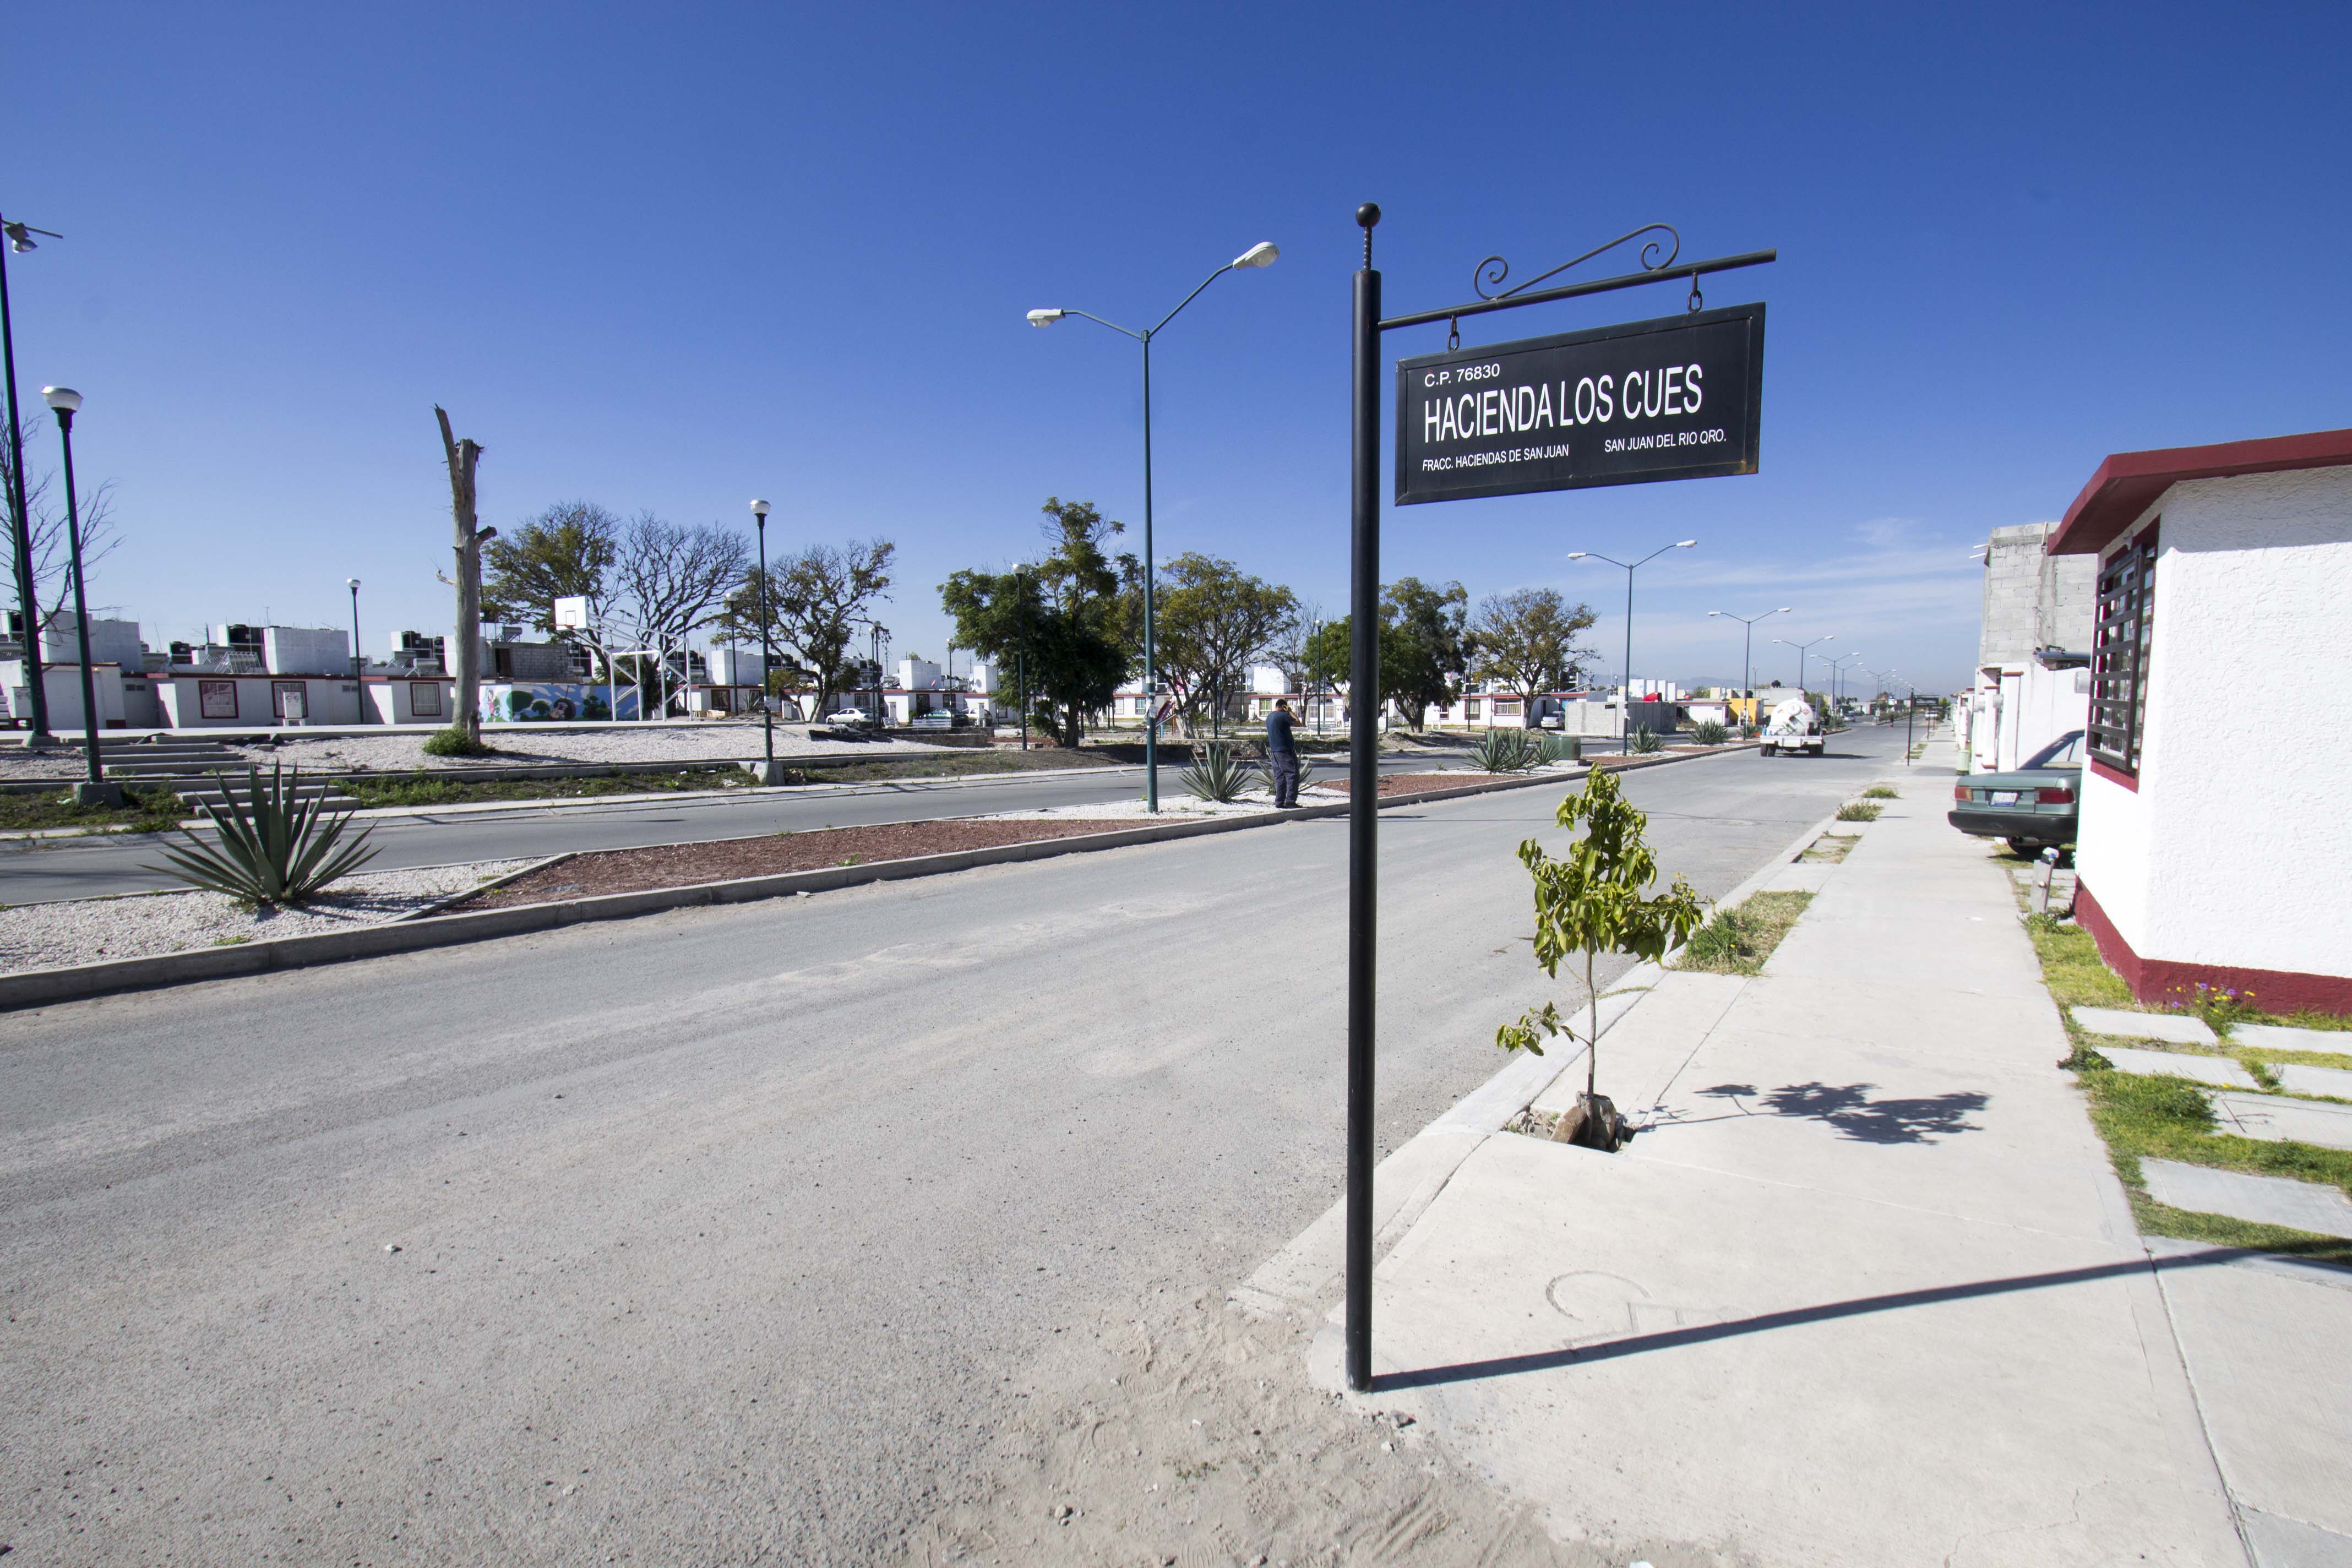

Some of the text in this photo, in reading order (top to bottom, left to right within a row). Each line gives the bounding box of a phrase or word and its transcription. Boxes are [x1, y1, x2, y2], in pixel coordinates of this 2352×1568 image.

[1424, 363, 1500, 388] C.P. 76830
[1425, 363, 1702, 443] HACIENDA LOS CUES
[1604, 428, 1727, 453] SAN JUAN DEL RIO QRO.
[1422, 443, 1569, 472] FRACC. HACIENDAS DE SAN JUAN
